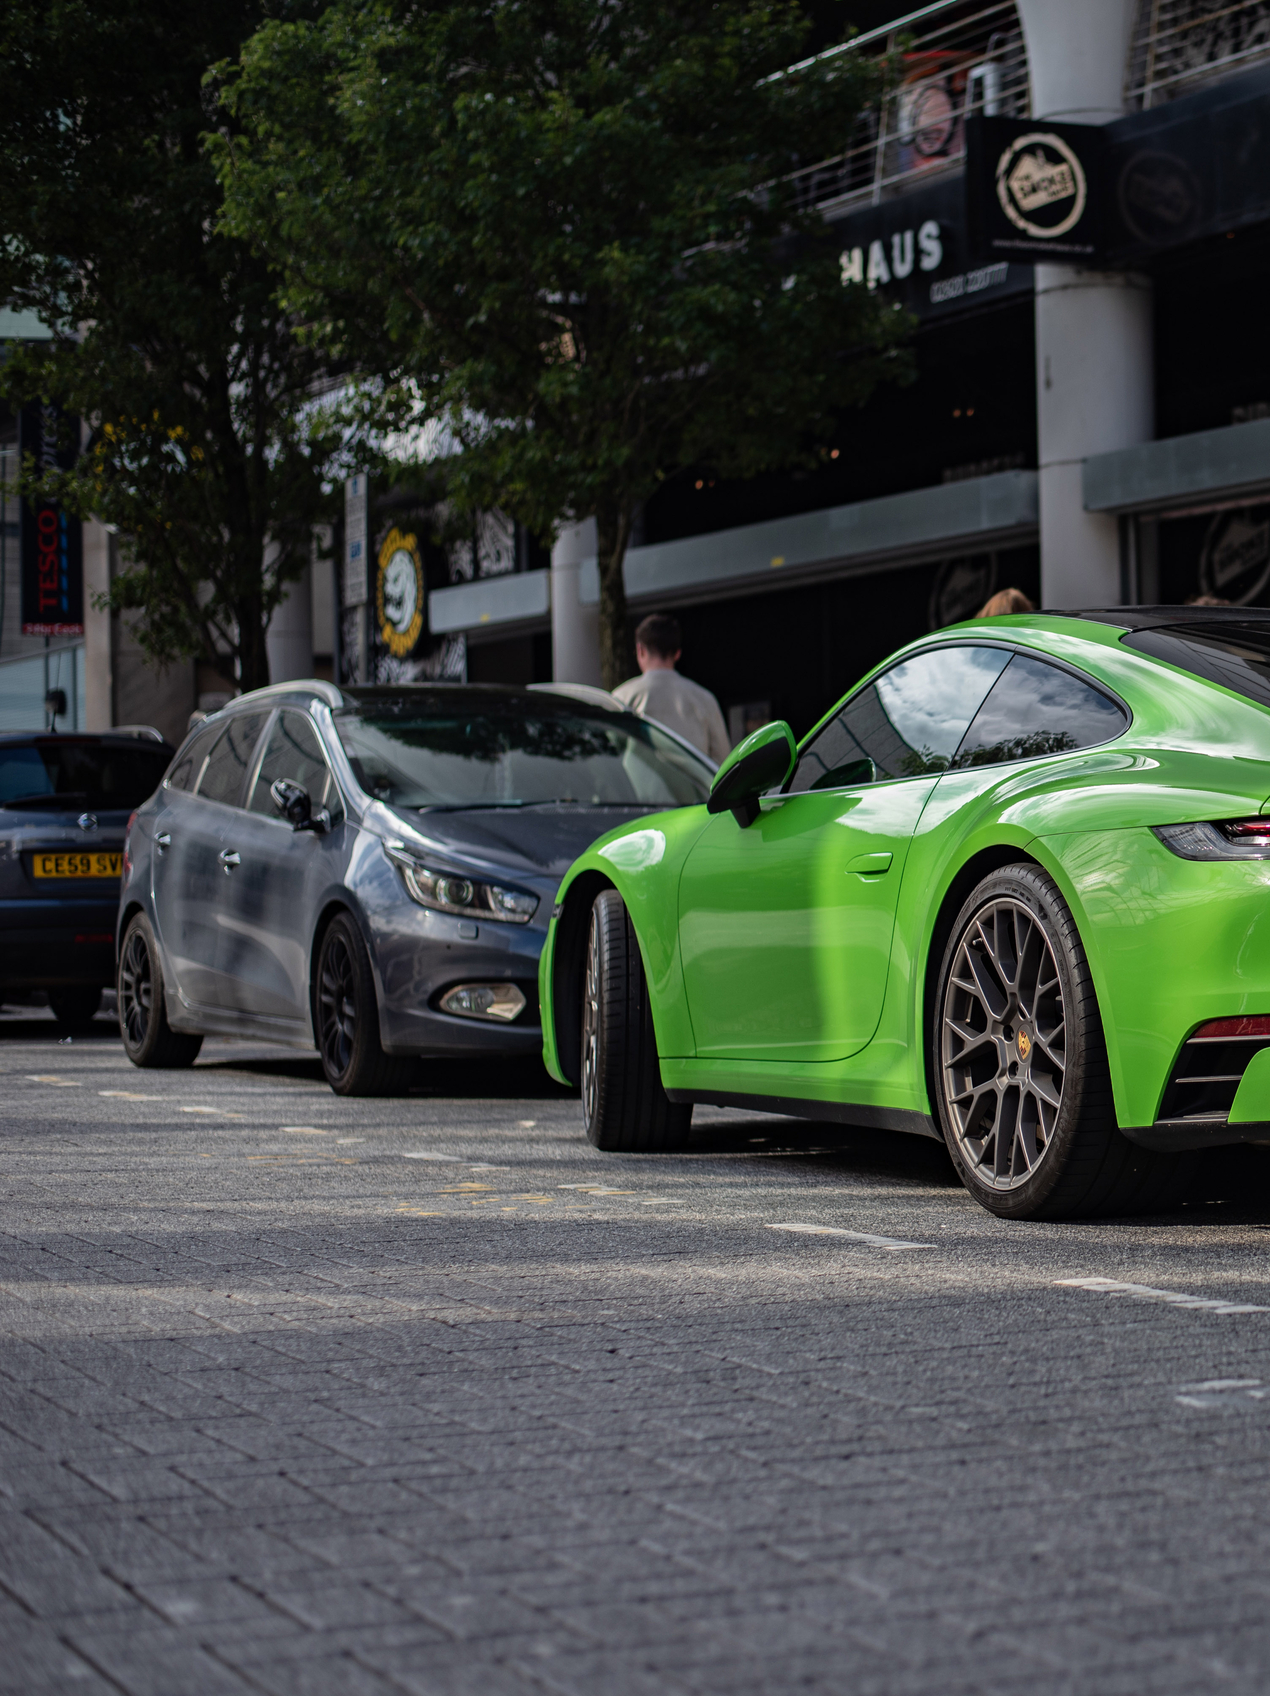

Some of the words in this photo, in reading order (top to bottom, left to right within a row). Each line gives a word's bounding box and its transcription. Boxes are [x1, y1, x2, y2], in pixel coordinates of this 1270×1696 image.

[839, 219, 943, 288] HAUS
[37, 509, 59, 614] TESCO
[42, 856, 91, 875] CE59
[97, 856, 122, 875] SV
